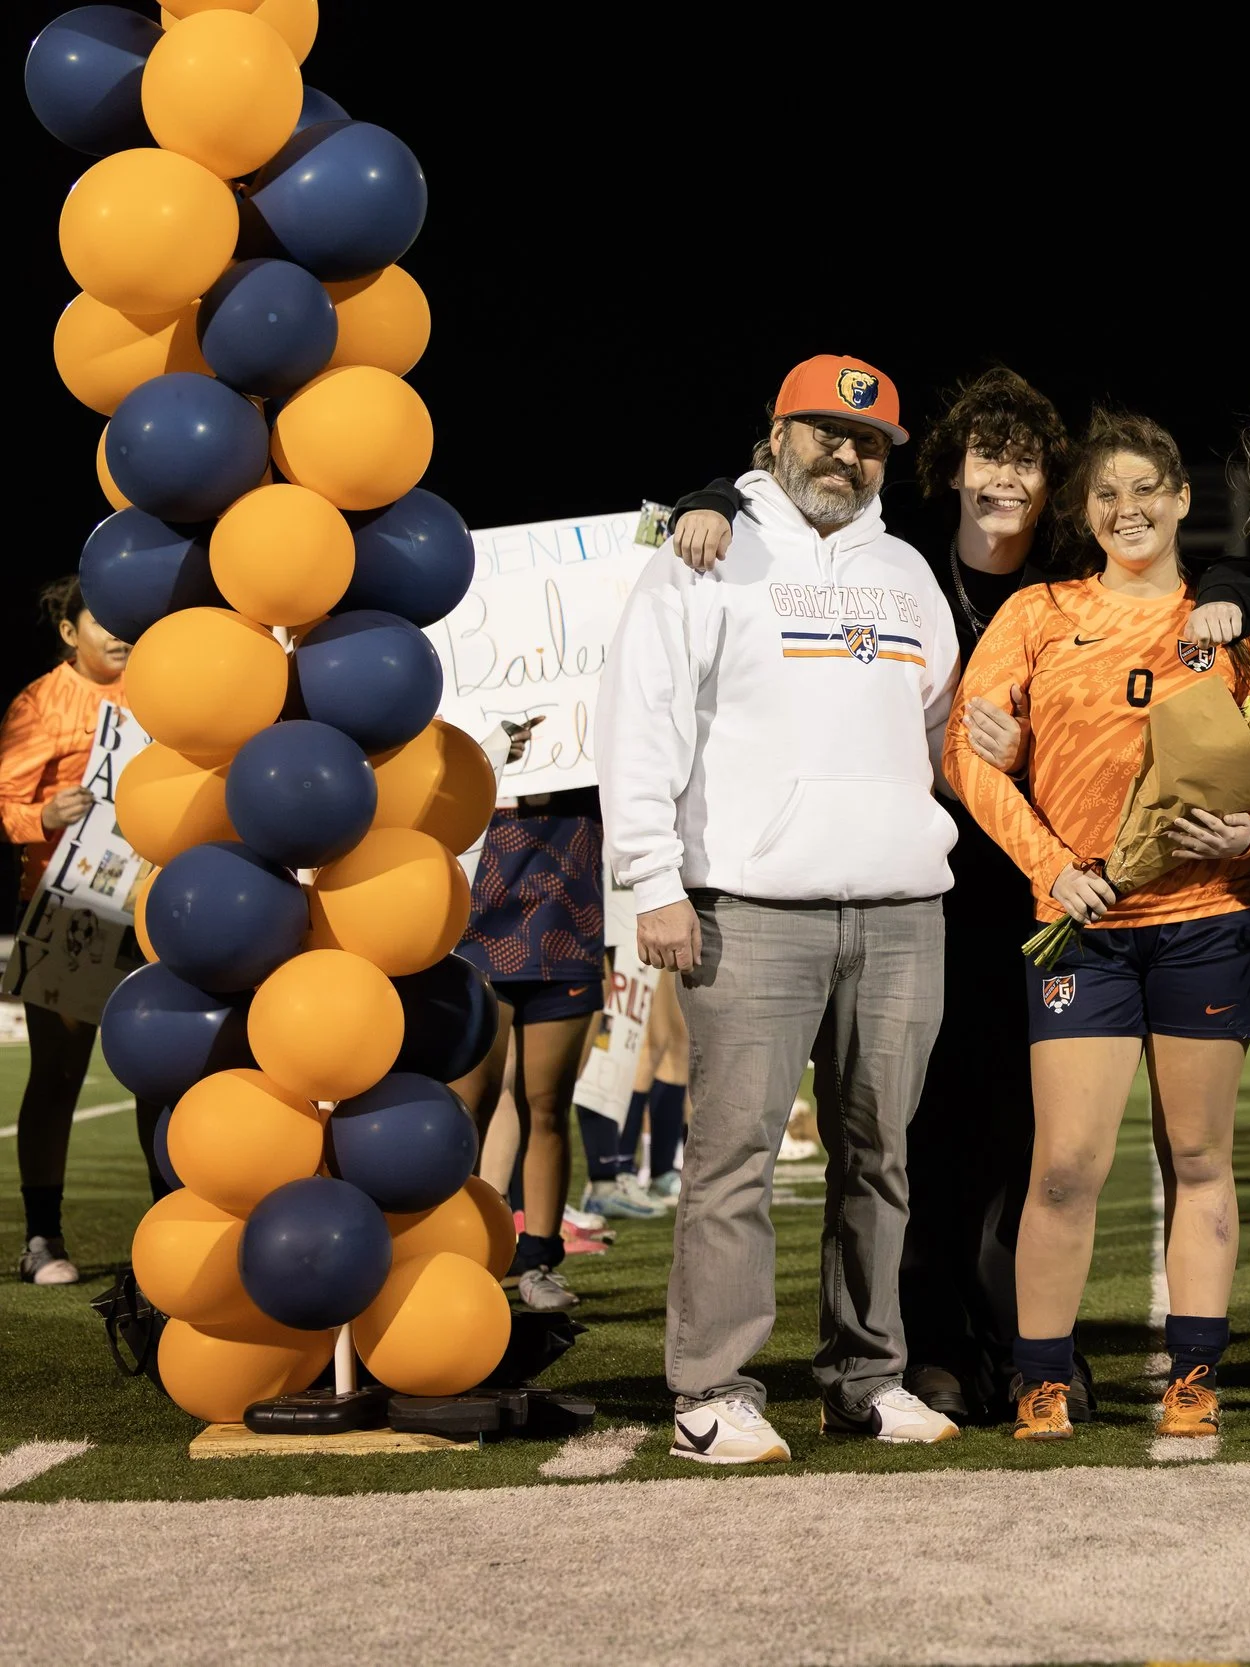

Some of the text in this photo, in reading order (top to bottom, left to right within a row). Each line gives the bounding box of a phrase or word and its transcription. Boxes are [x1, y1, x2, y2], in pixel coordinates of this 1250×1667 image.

[474, 518, 637, 582] SENIOR
[769, 583, 922, 628] GRIZZLY FC
[445, 573, 607, 698] Baile
[1127, 669, 1153, 708] 0
[1060, 983, 1070, 999] G
